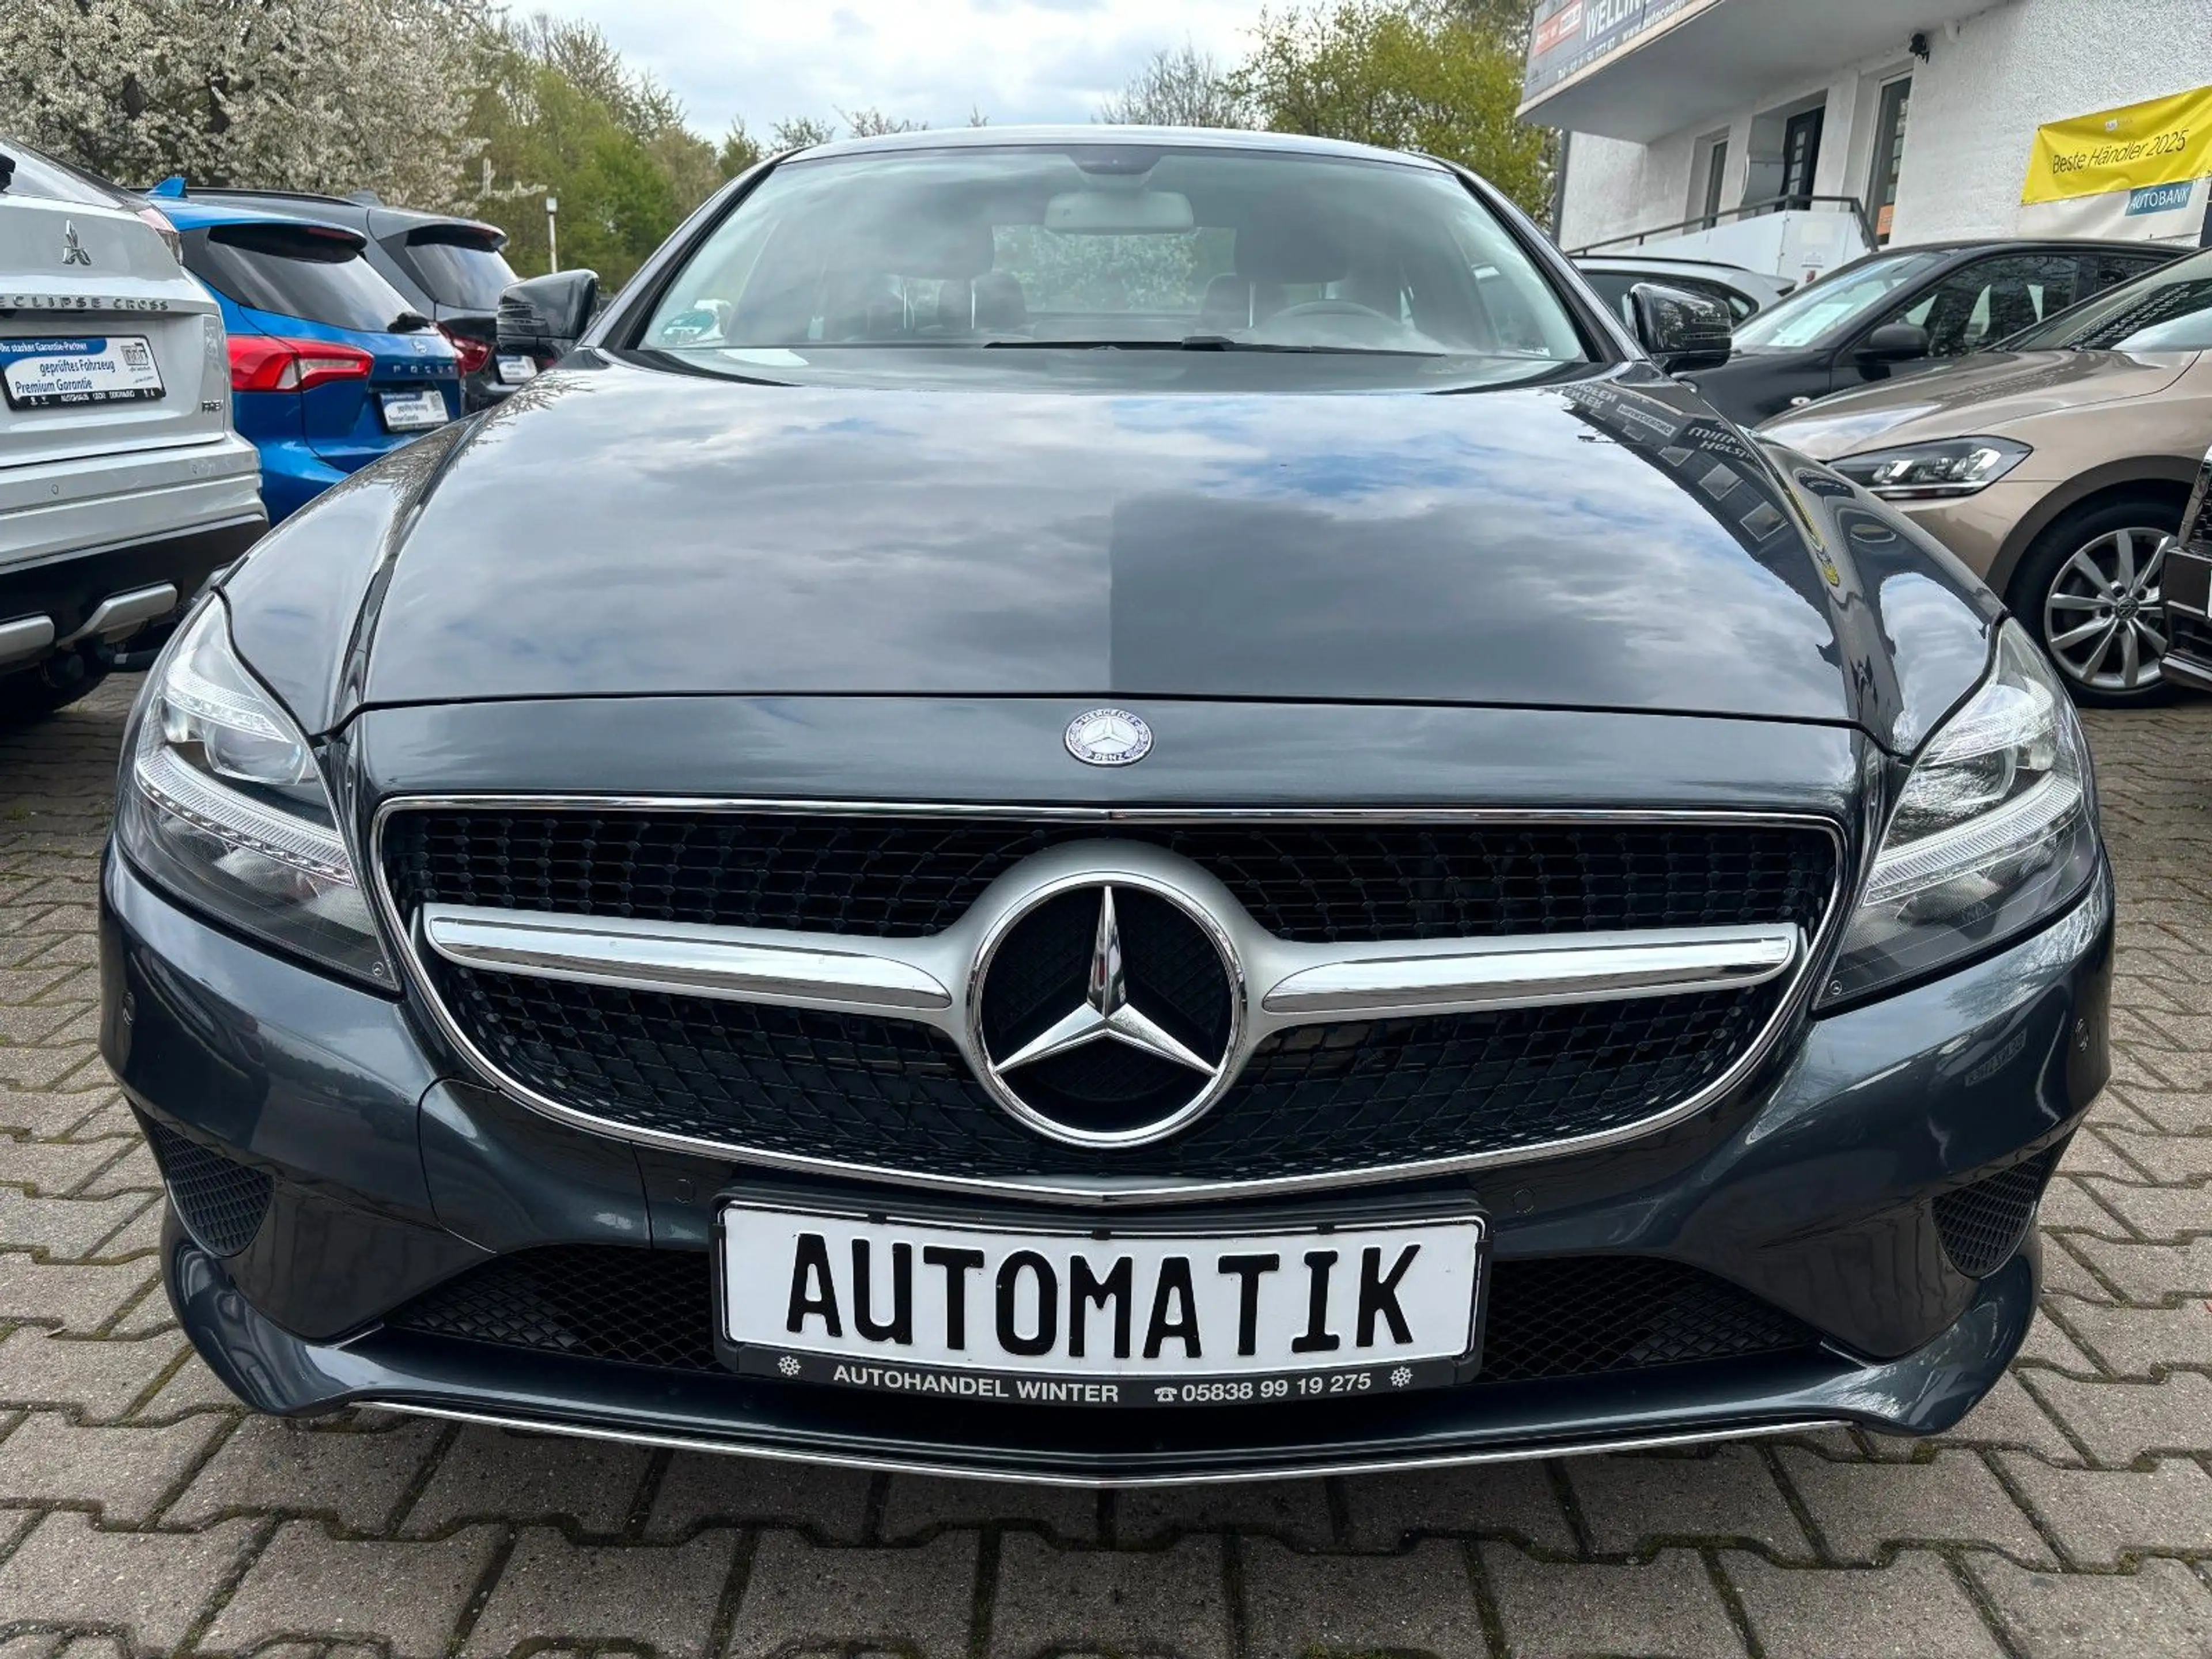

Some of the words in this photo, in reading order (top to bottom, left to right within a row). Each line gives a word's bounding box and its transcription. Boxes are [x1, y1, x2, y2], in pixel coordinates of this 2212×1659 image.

[2053, 152, 2087, 173] Beste
[2088, 141, 2148, 167] Händler
[2146, 128, 2190, 157] 2025
[2130, 187, 2190, 210] AUTOBANK
[113, 298, 168, 310] CROSS
[40, 359, 79, 377] geprüftes
[79, 357, 115, 376] Fahrzeug
[15, 380, 56, 394] Premium
[56, 377, 93, 391] Garantie
[786, 1233, 1421, 1358] AUTOMATIK
[833, 1364, 1009, 1398] AUTOHANDEL
[1017, 1380, 1119, 1403] WINTER
[1181, 1381, 1253, 1403] 05838
[1260, 1378, 1289, 1398] 99
[1297, 1376, 1323, 1394] 19
[1330, 1372, 1372, 1393] 275
